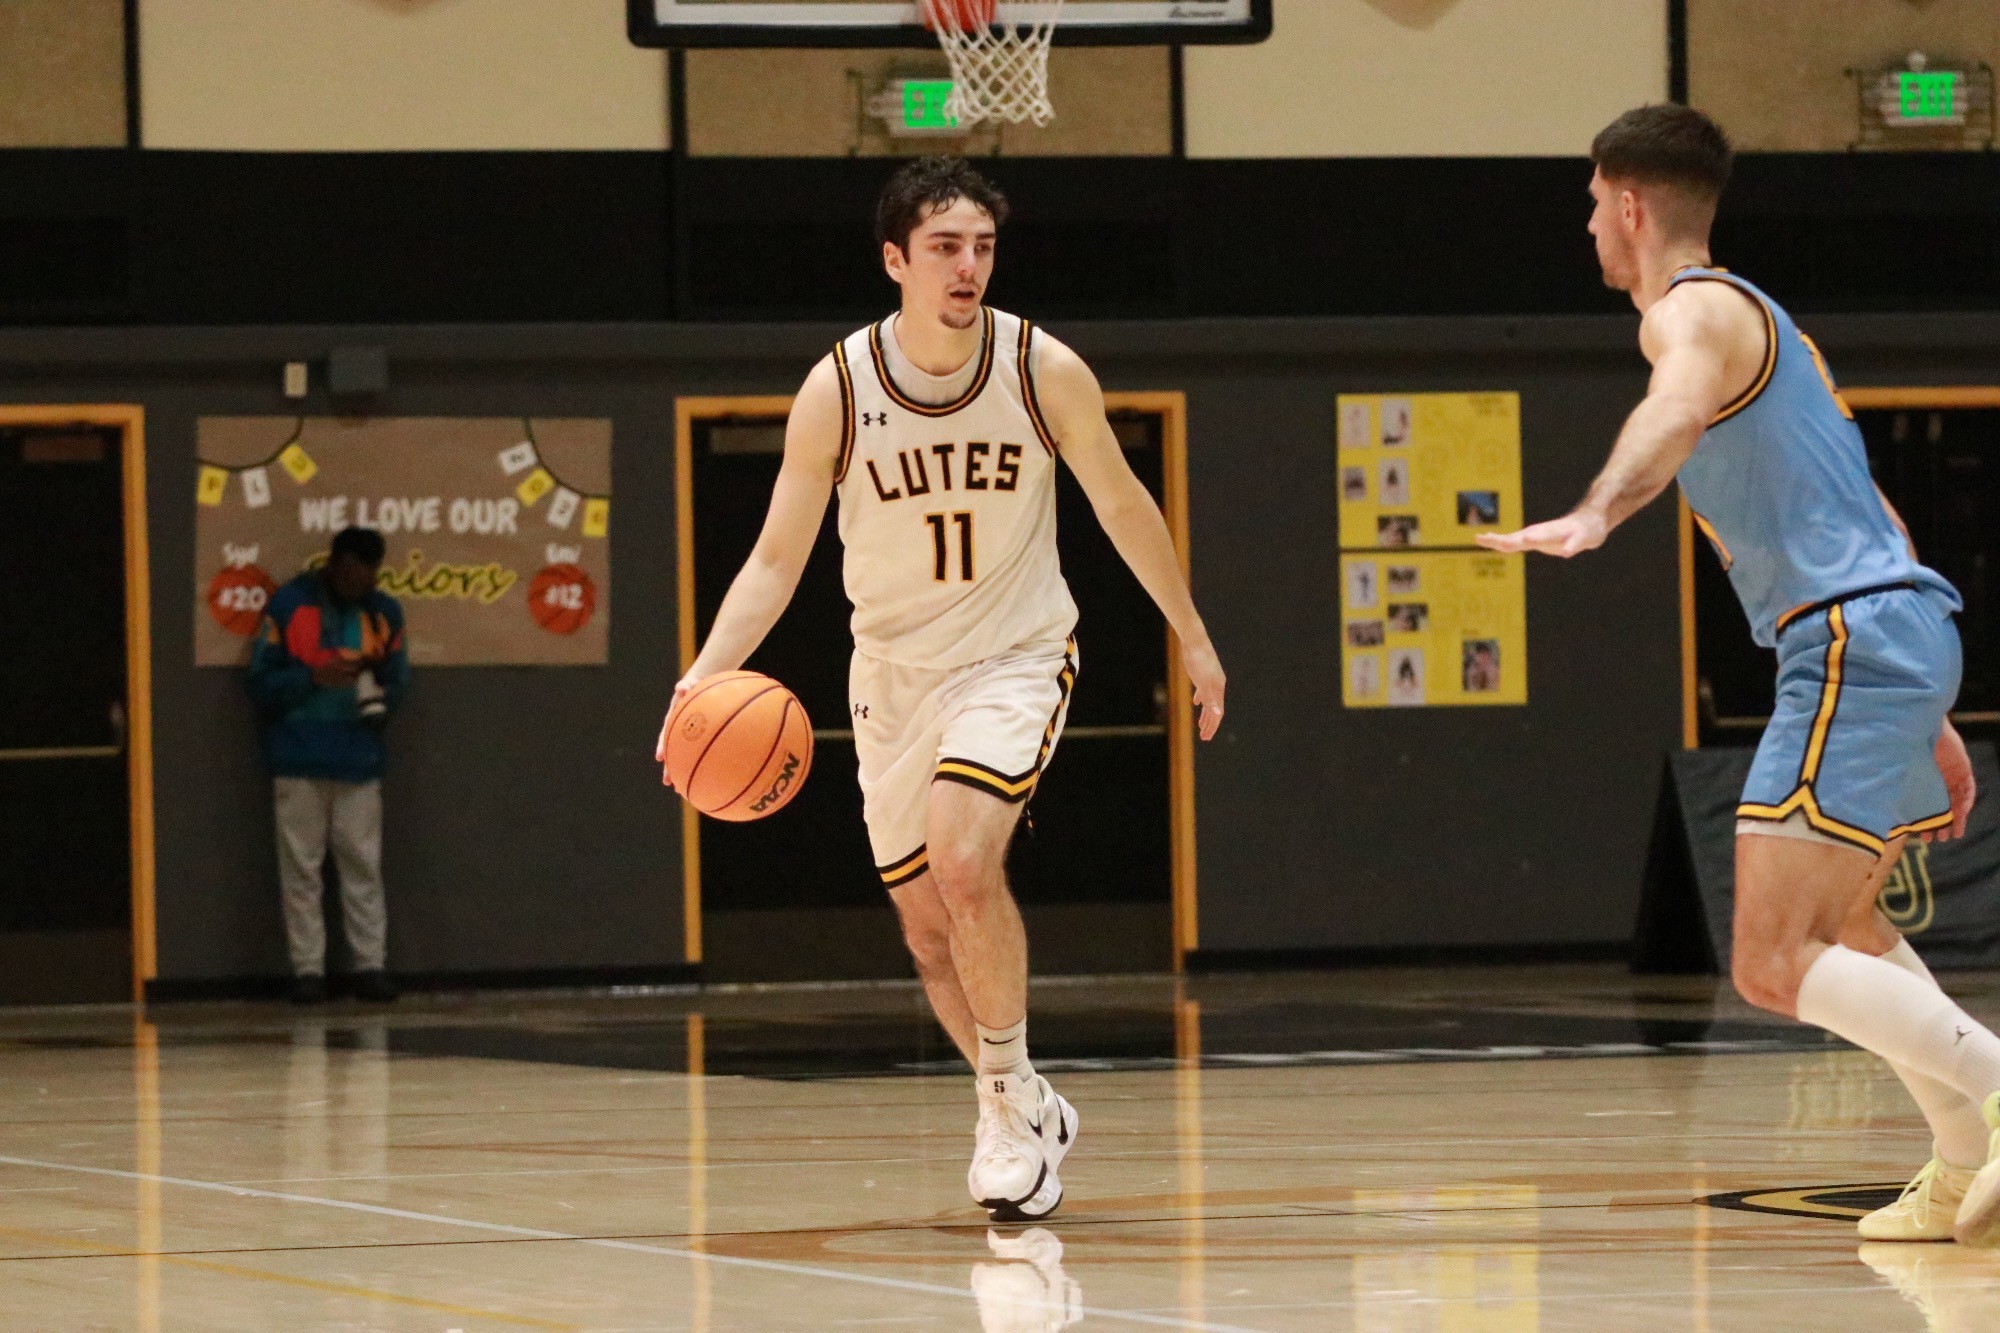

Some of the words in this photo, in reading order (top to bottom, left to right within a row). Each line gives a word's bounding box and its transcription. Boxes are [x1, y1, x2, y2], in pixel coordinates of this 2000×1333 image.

[866, 441, 1023, 502] LUTES
[299, 496, 349, 532] WE
[356, 496, 442, 533] LOVE
[450, 497, 519, 535] OUR
[924, 509, 976, 583] 11
[218, 585, 268, 612] #20
[542, 583, 584, 610] #12
[749, 751, 800, 812] NCAA
